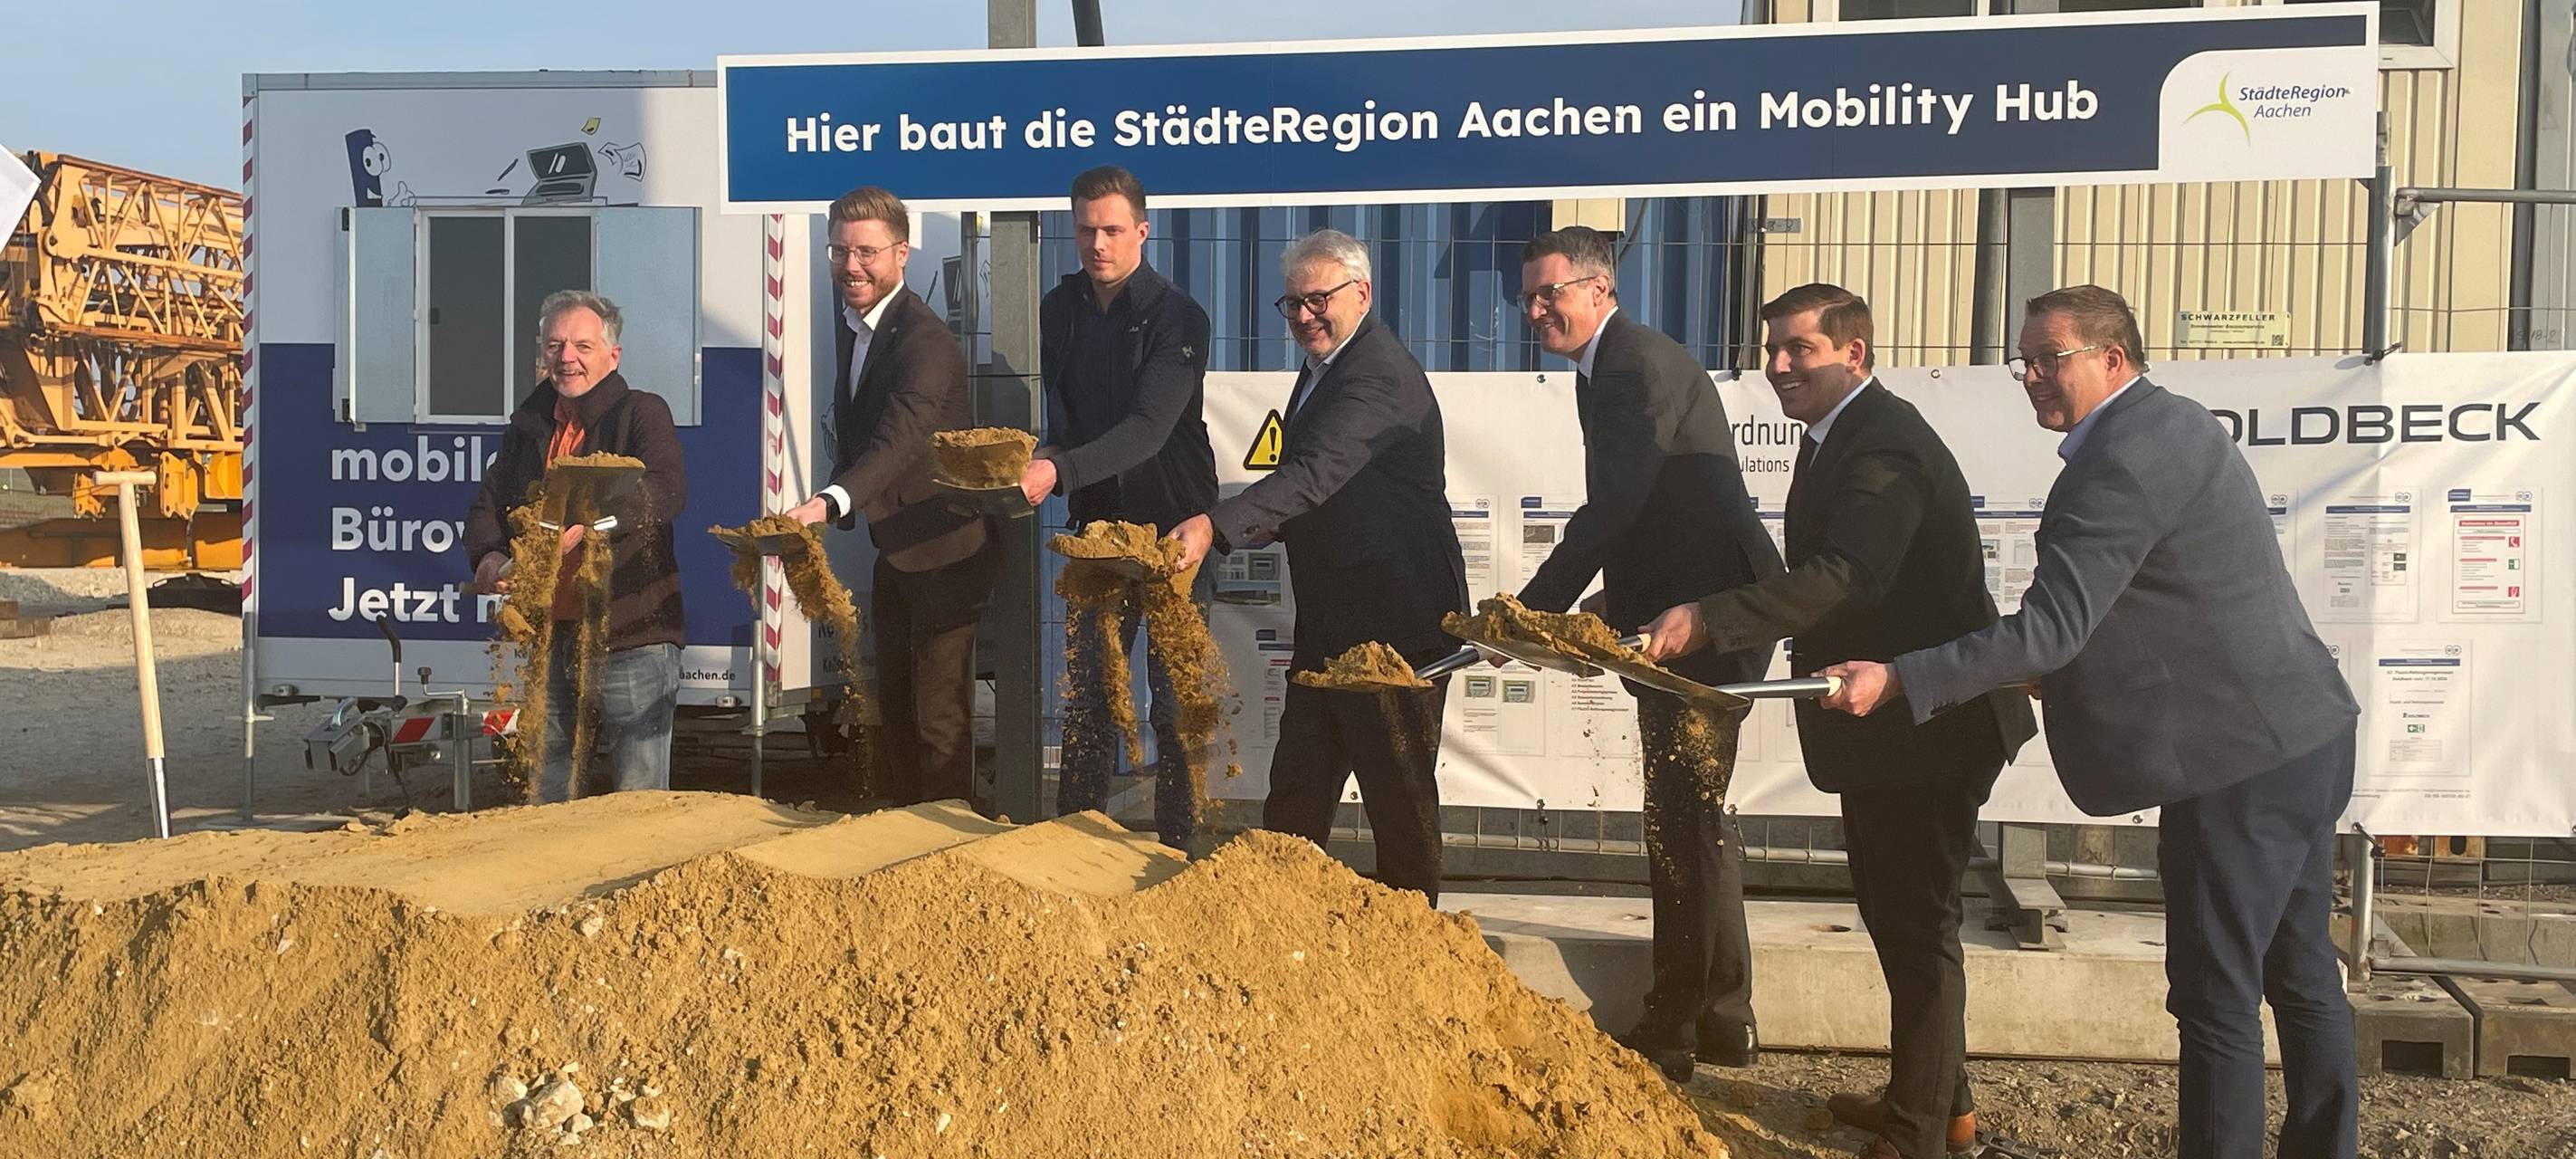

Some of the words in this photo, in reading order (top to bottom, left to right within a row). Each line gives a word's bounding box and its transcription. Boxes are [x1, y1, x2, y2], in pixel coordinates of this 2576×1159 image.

[2238, 84, 2346, 101] StädteRegion
[787, 111, 881, 152] Hier
[899, 113, 1007, 151] baut
[1024, 107, 1096, 148] die
[1113, 100, 1438, 152] StädteRegion
[1457, 97, 1642, 139] Aachen
[1663, 90, 1737, 132] ein
[1760, 82, 1974, 135] Mobility
[1996, 80, 2099, 121] Hub
[2254, 103, 2312, 118] Aachen
[2180, 313, 2275, 321] SCHWARZFELLER
[2209, 402, 2542, 446] OLDBECK
[328, 577, 460, 623] Jetzt
